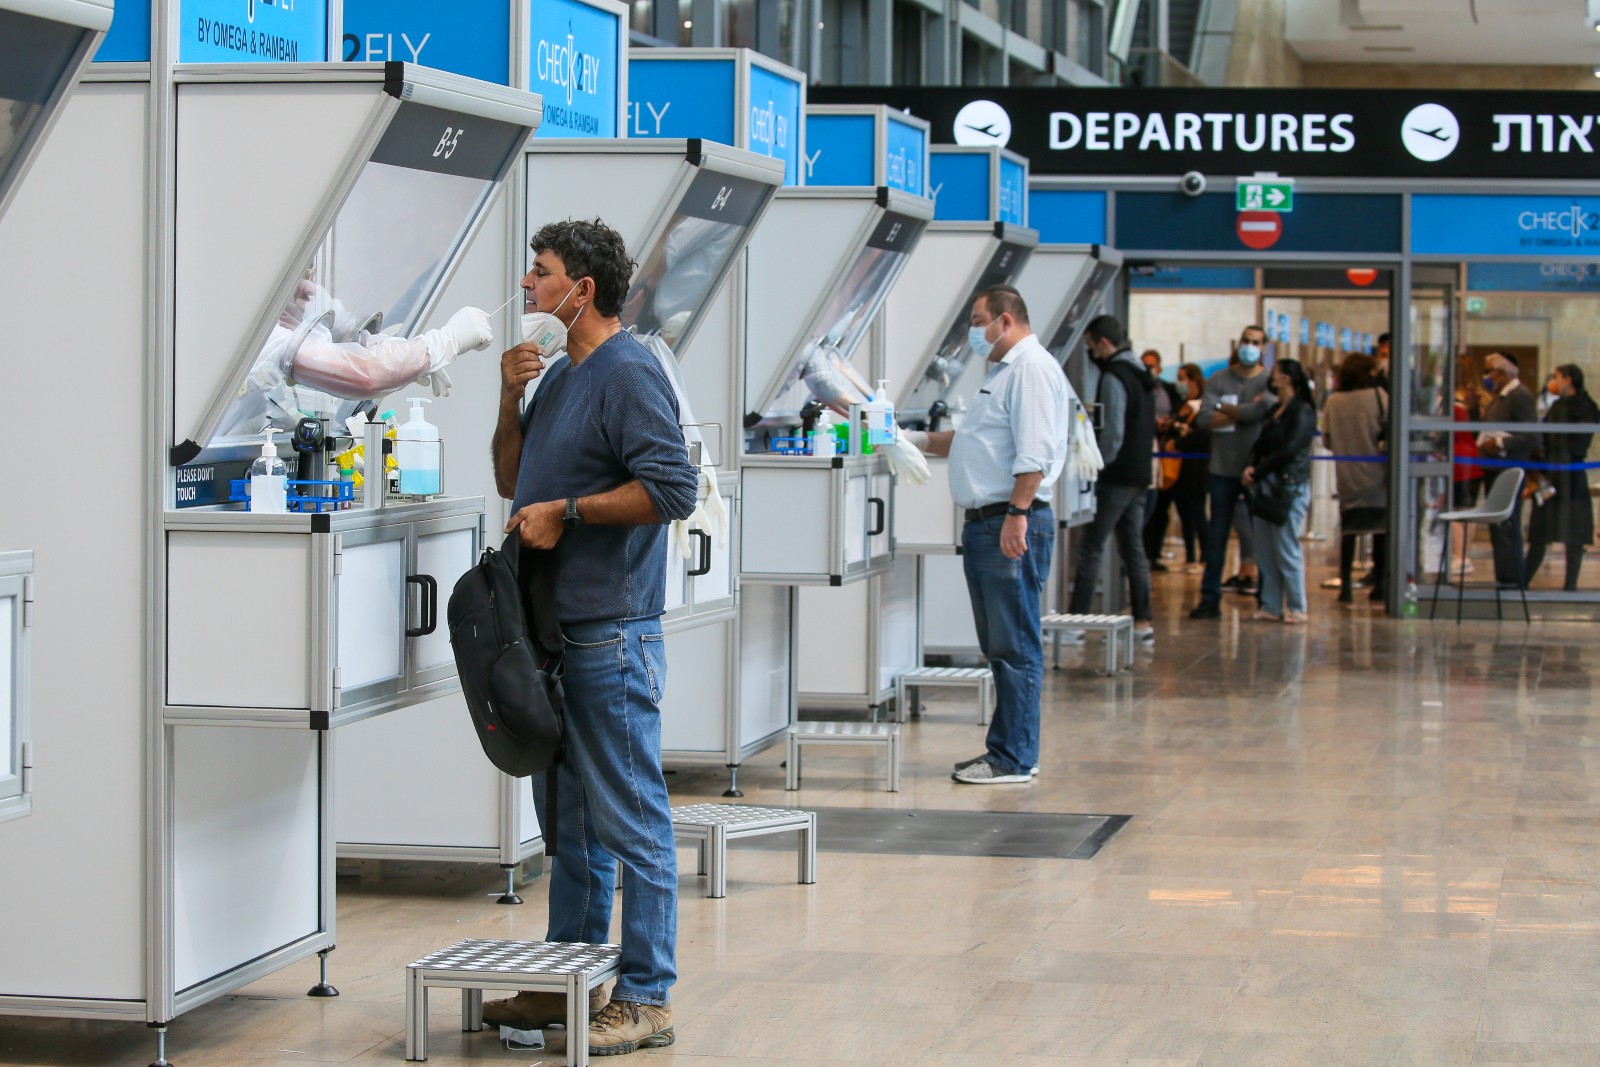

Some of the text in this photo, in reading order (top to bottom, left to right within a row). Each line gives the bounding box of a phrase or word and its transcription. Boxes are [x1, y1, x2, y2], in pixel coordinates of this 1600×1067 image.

[198, 17, 298, 62] BY OMEGA & RAMBAM
[546, 105, 568, 127] OMEGA
[569, 110, 574, 129] &
[574, 112, 599, 135] RAMBAM
[1049, 111, 1355, 152] DEPARTURES
[1491, 114, 1600, 153] אות
[432, 126, 464, 159] B-5
[710, 186, 733, 211] B-4
[177, 467, 214, 483] PLEASE DON'T
[177, 487, 196, 501] TOUCH
